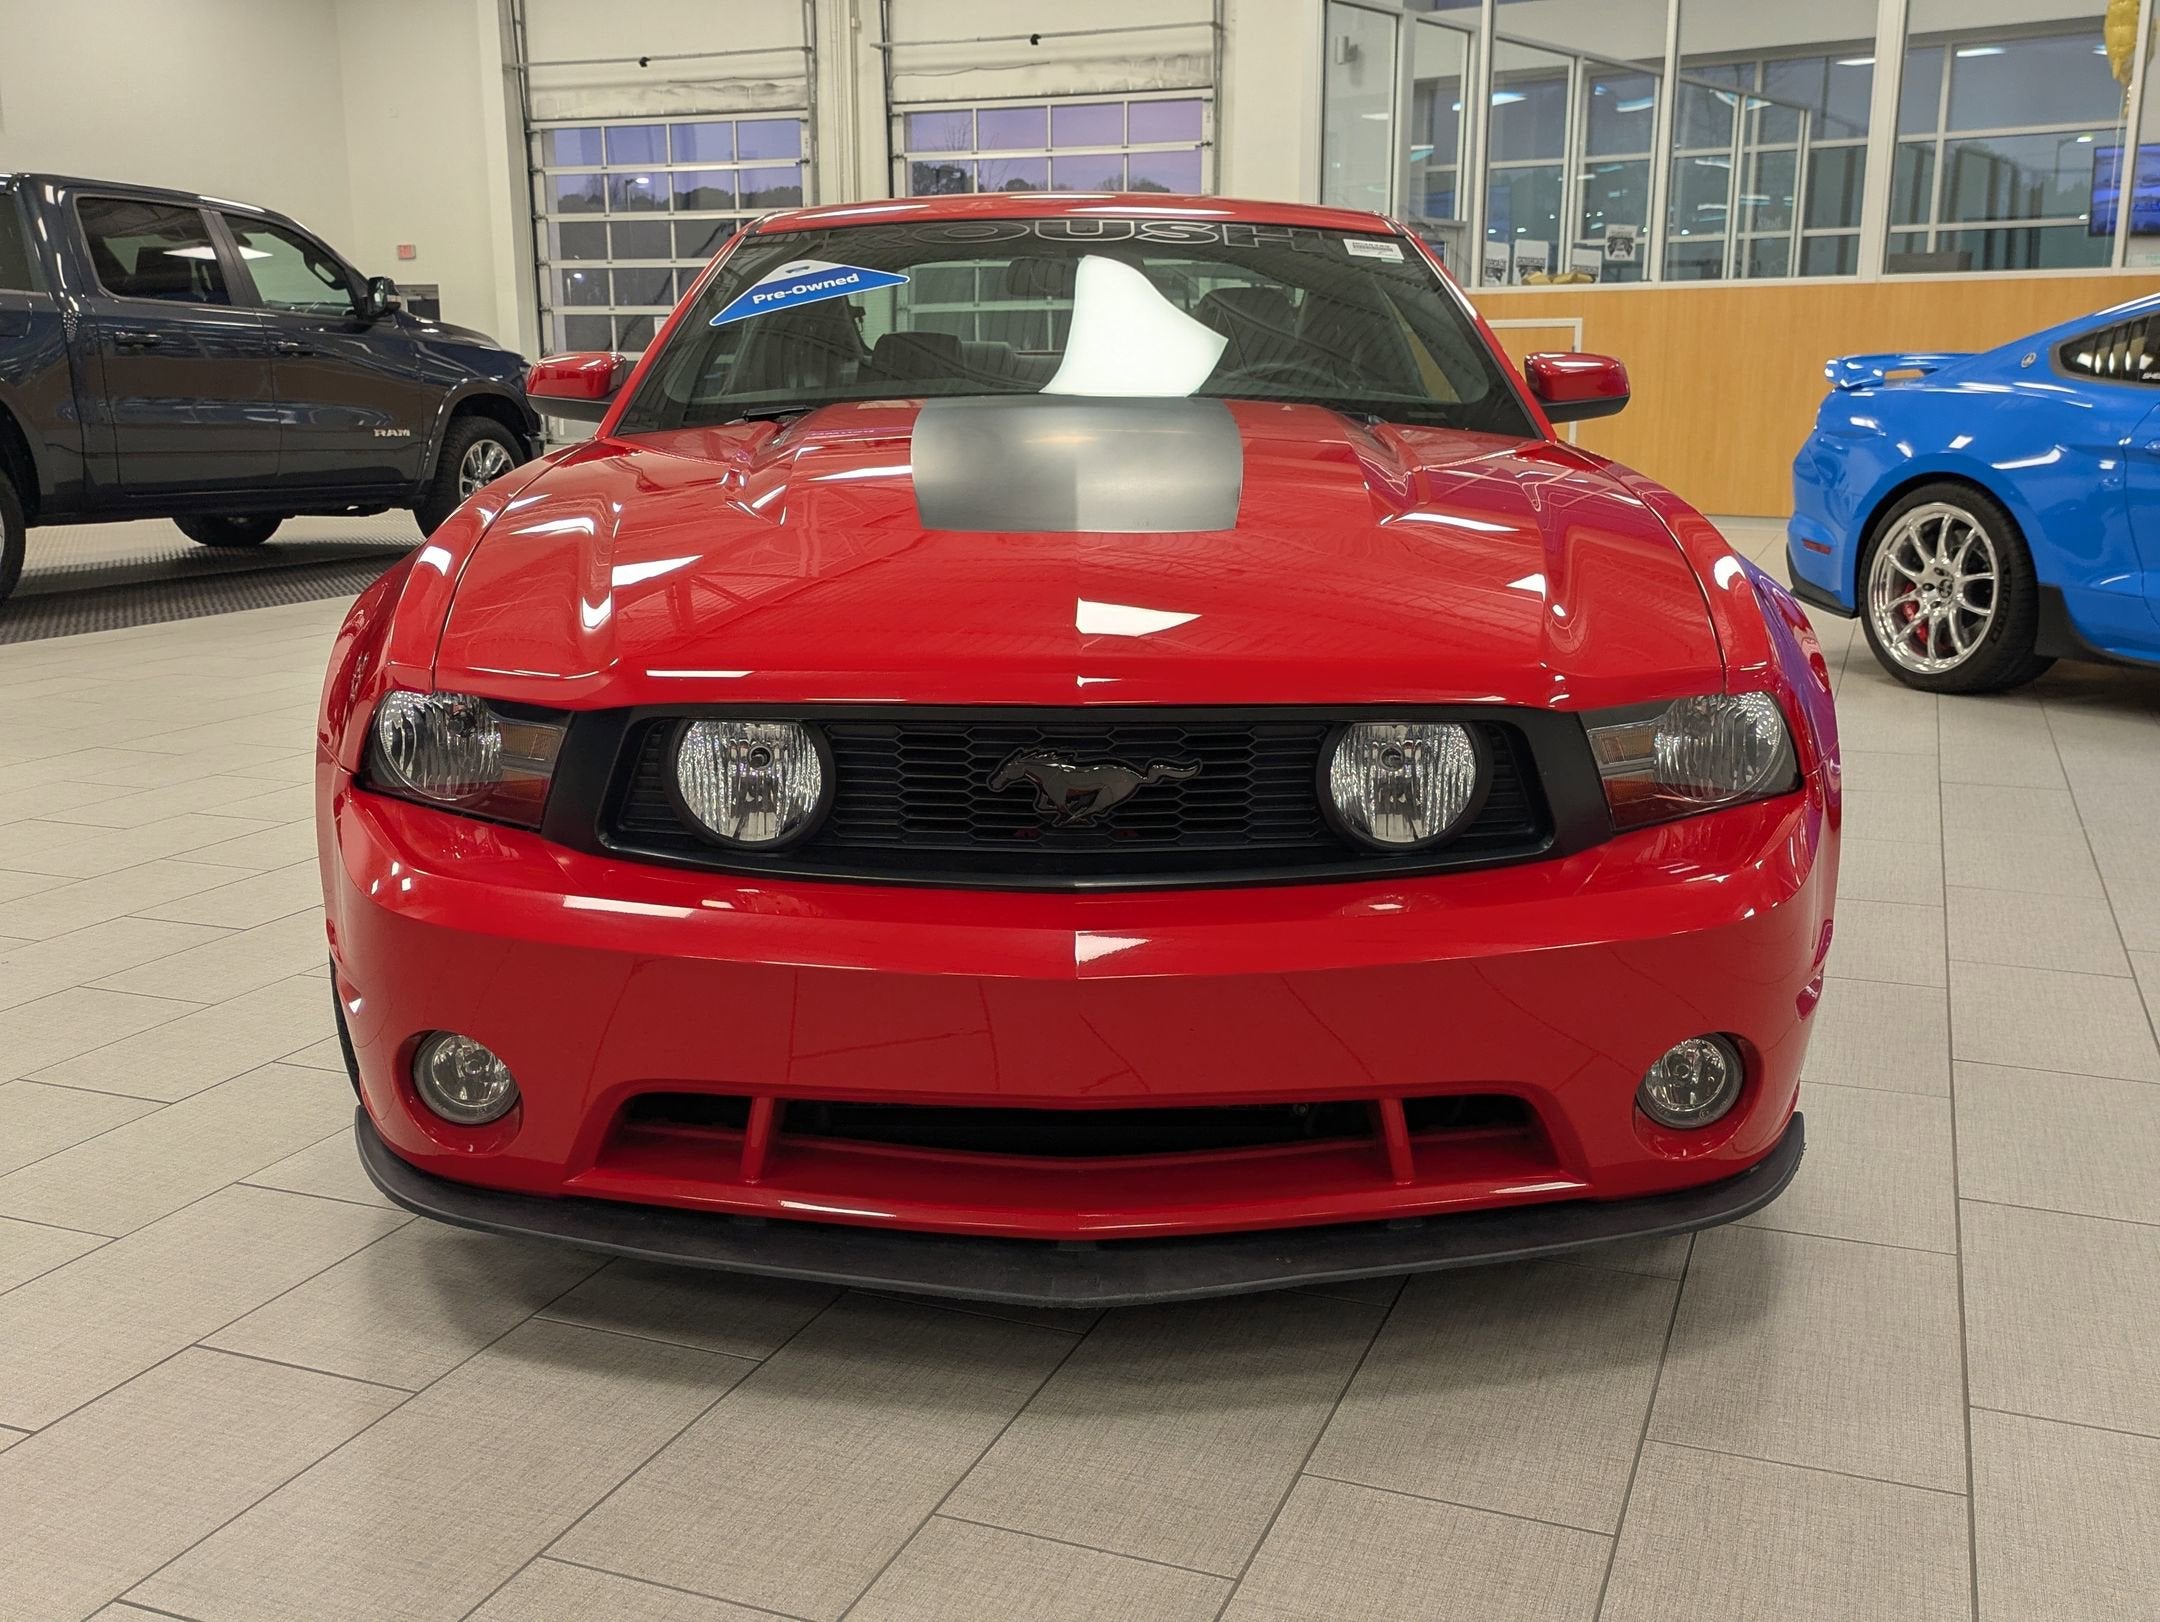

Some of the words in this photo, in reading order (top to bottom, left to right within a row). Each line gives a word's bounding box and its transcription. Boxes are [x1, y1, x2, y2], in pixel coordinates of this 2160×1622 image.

[828, 218, 1327, 252] ROUSH
[752, 273, 860, 305] Pre-Owned
[373, 428, 411, 437] RAM
